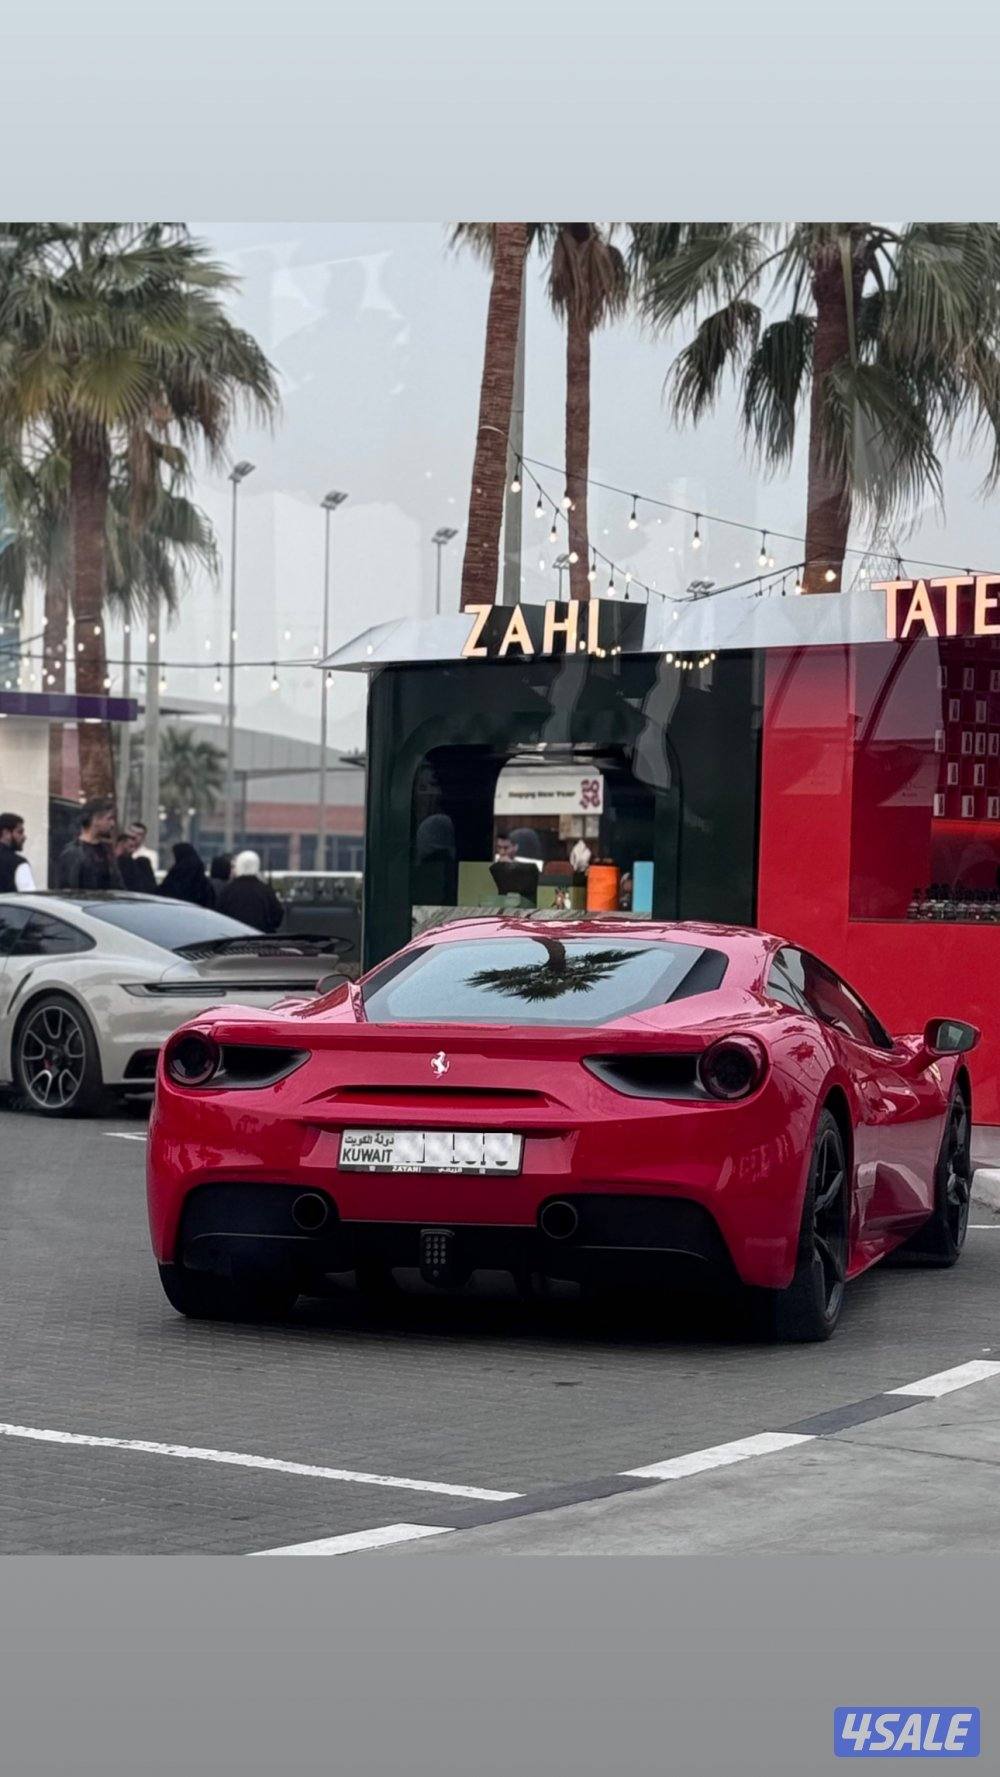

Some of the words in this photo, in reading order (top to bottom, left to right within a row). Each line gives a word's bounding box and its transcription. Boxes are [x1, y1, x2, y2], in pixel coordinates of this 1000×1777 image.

[870, 575, 1000, 638] TATE
[344, 1134, 373, 1147] الكويت
[374, 1133, 394, 1147] دولة
[342, 1148, 393, 1163] KUWAIT
